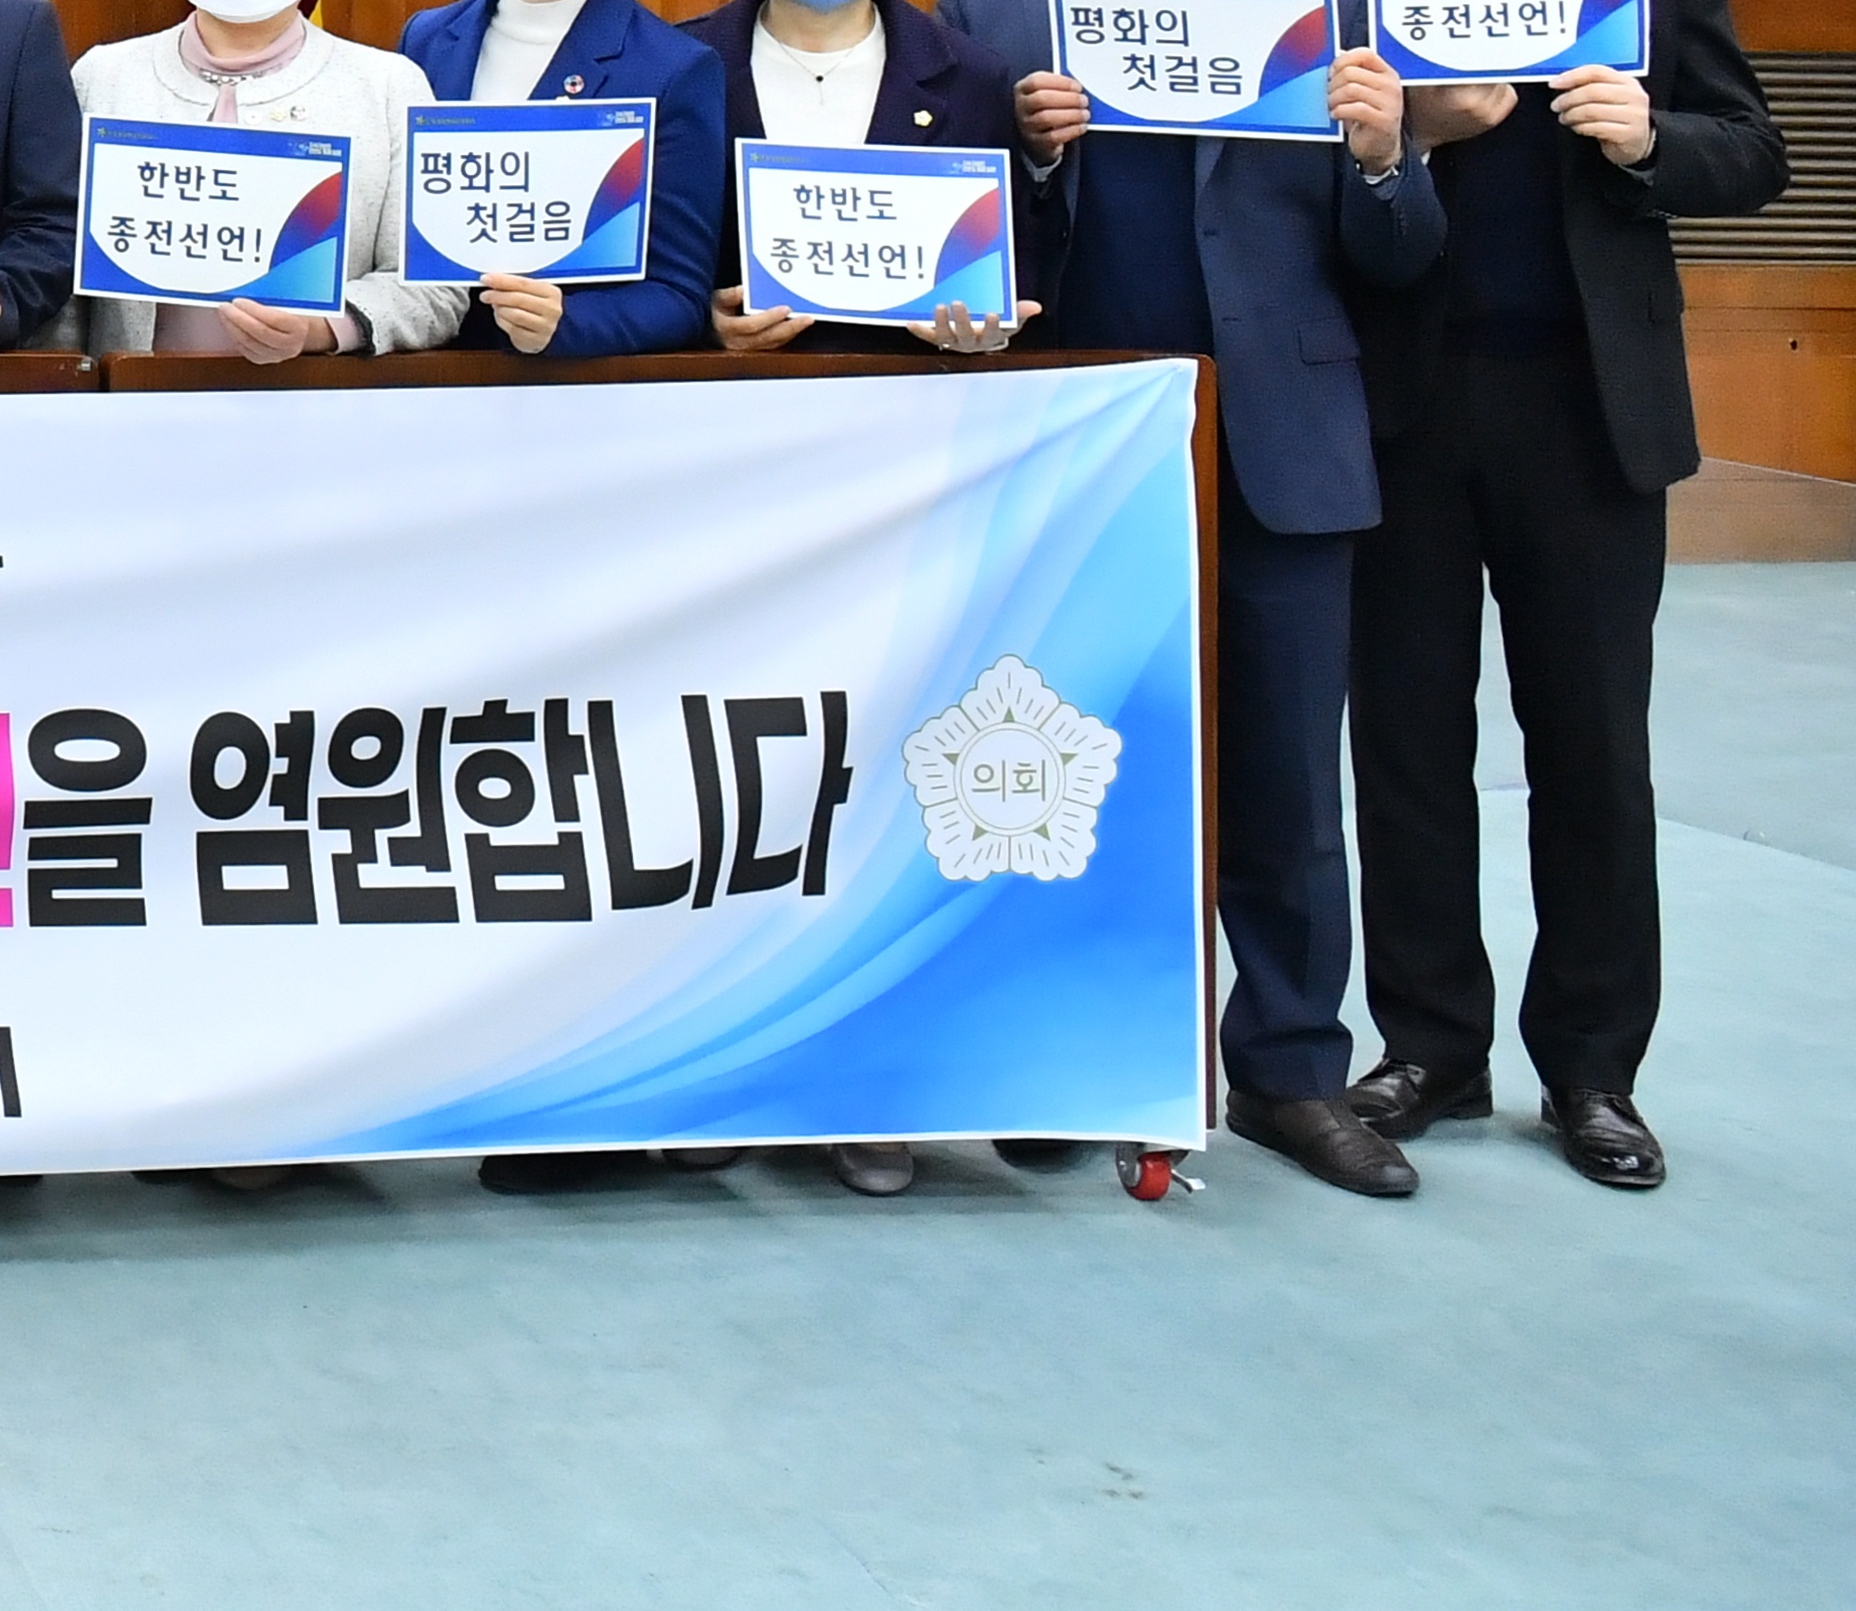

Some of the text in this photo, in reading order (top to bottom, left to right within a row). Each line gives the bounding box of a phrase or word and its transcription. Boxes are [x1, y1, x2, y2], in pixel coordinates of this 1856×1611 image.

[1070, 6, 1190, 48] 평화의
[1401, 1, 1567, 40] 종전선언!
[1123, 54, 1242, 94] 첫걸음
[138, 161, 240, 202] 한반도
[421, 152, 529, 194] 평화의
[467, 201, 571, 243] 첫걸음
[794, 186, 896, 221] 한반도
[106, 215, 262, 265] 종전선언!
[770, 237, 925, 281] 종전선언!
[972, 760, 1045, 802] 의회
[190, 691, 854, 925] 염원합니다
